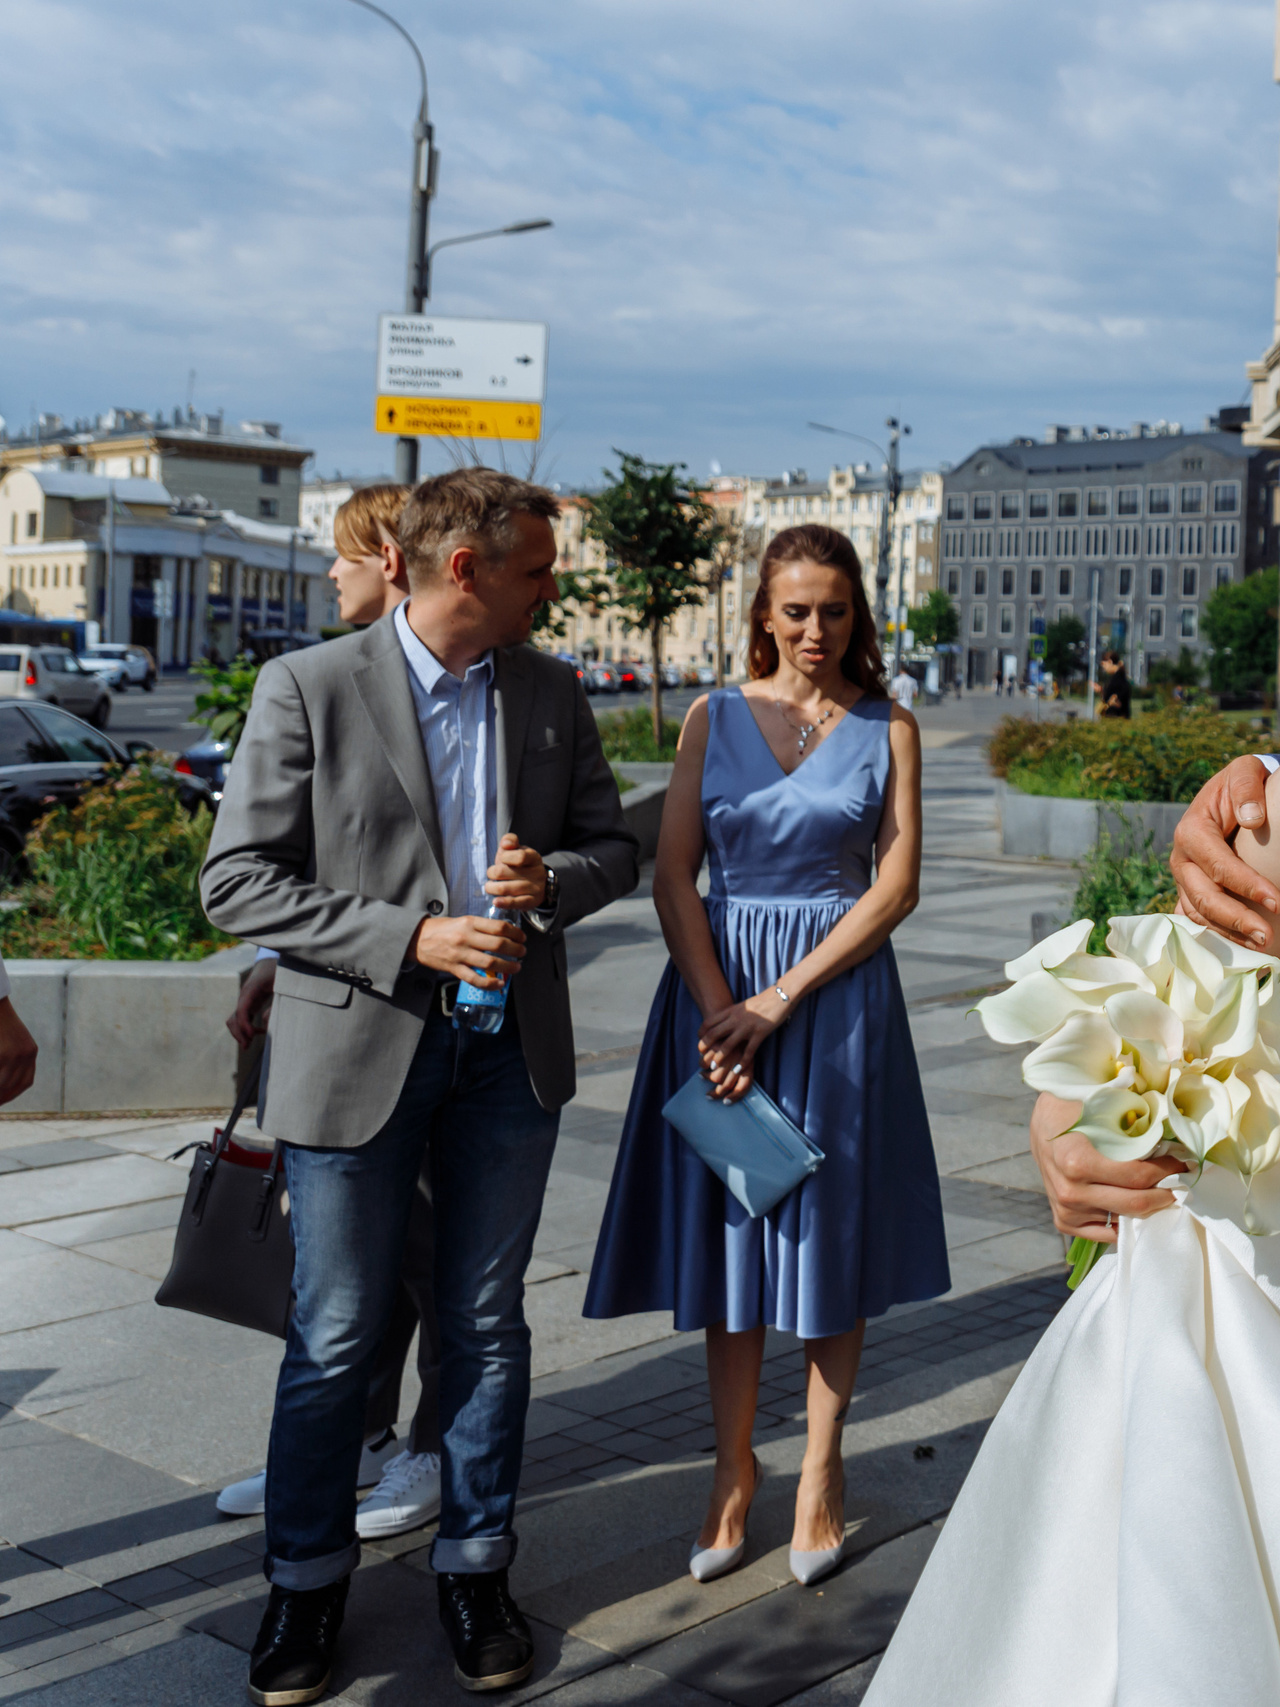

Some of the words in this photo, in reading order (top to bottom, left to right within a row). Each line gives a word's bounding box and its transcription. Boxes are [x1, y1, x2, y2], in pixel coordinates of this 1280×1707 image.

[389, 334, 455, 347] ЯКИМАНКА
[388, 346, 424, 357] улица
[387, 366, 463, 379] БРОДНИКОВ
